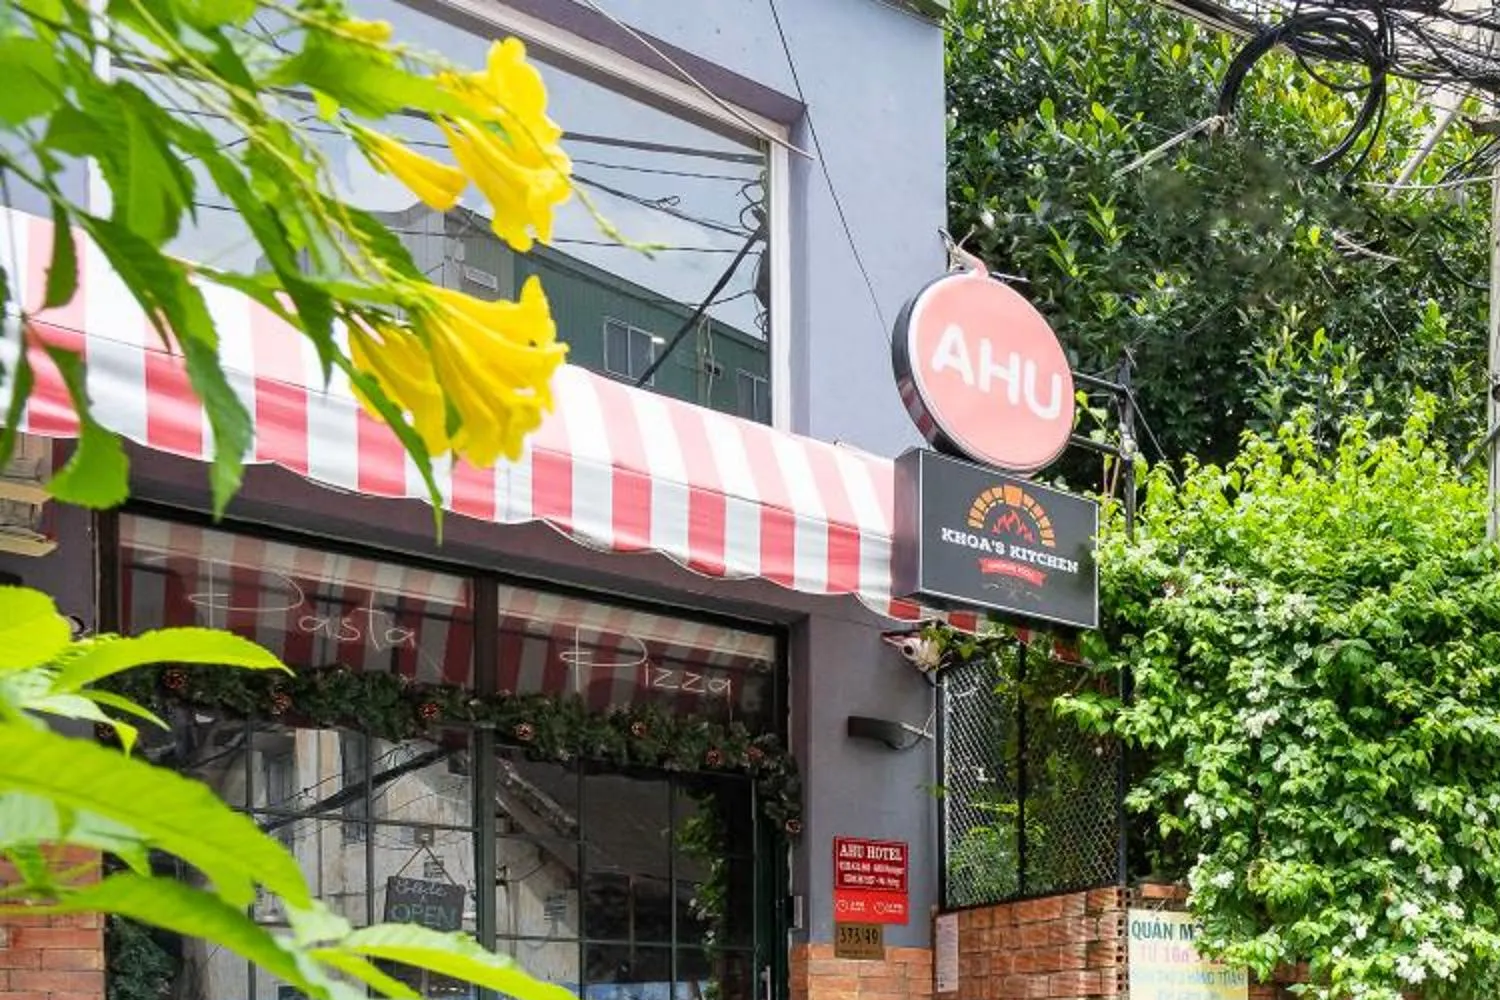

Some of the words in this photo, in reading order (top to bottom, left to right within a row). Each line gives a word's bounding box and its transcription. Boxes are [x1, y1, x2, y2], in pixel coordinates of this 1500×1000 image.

[931, 324, 1062, 420] AHU
[941, 527, 1006, 556] KHOA'S
[1009, 545, 1079, 574] KITCHEN
[190, 560, 416, 651] Pasta
[560, 626, 733, 722] Pizza
[867, 846, 903, 862] HOTEL
[390, 903, 459, 929] OPEN
